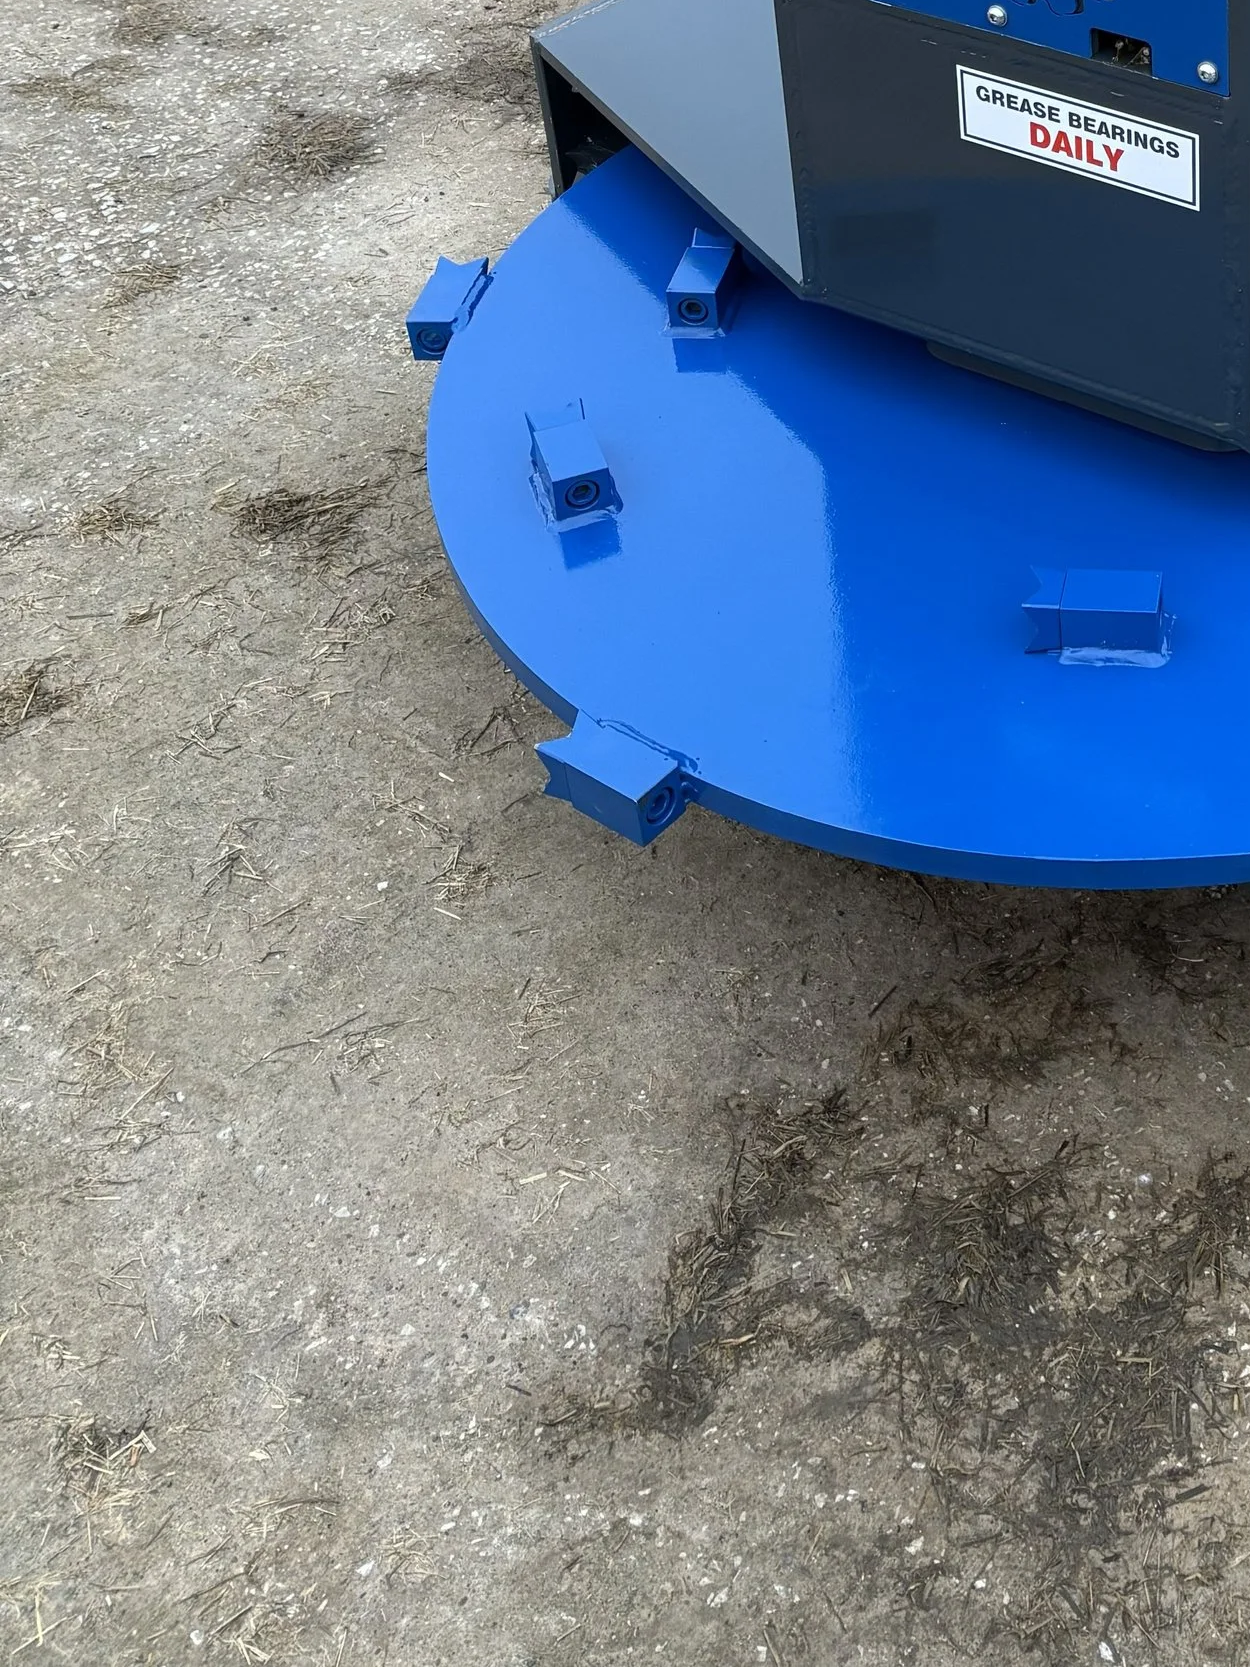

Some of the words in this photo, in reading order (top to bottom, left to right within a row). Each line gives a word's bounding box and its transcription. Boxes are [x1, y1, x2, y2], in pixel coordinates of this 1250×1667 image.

[975, 84, 1061, 124] GREASE
[1068, 110, 1180, 159] BEARINGS
[1029, 120, 1124, 173] DAILY
